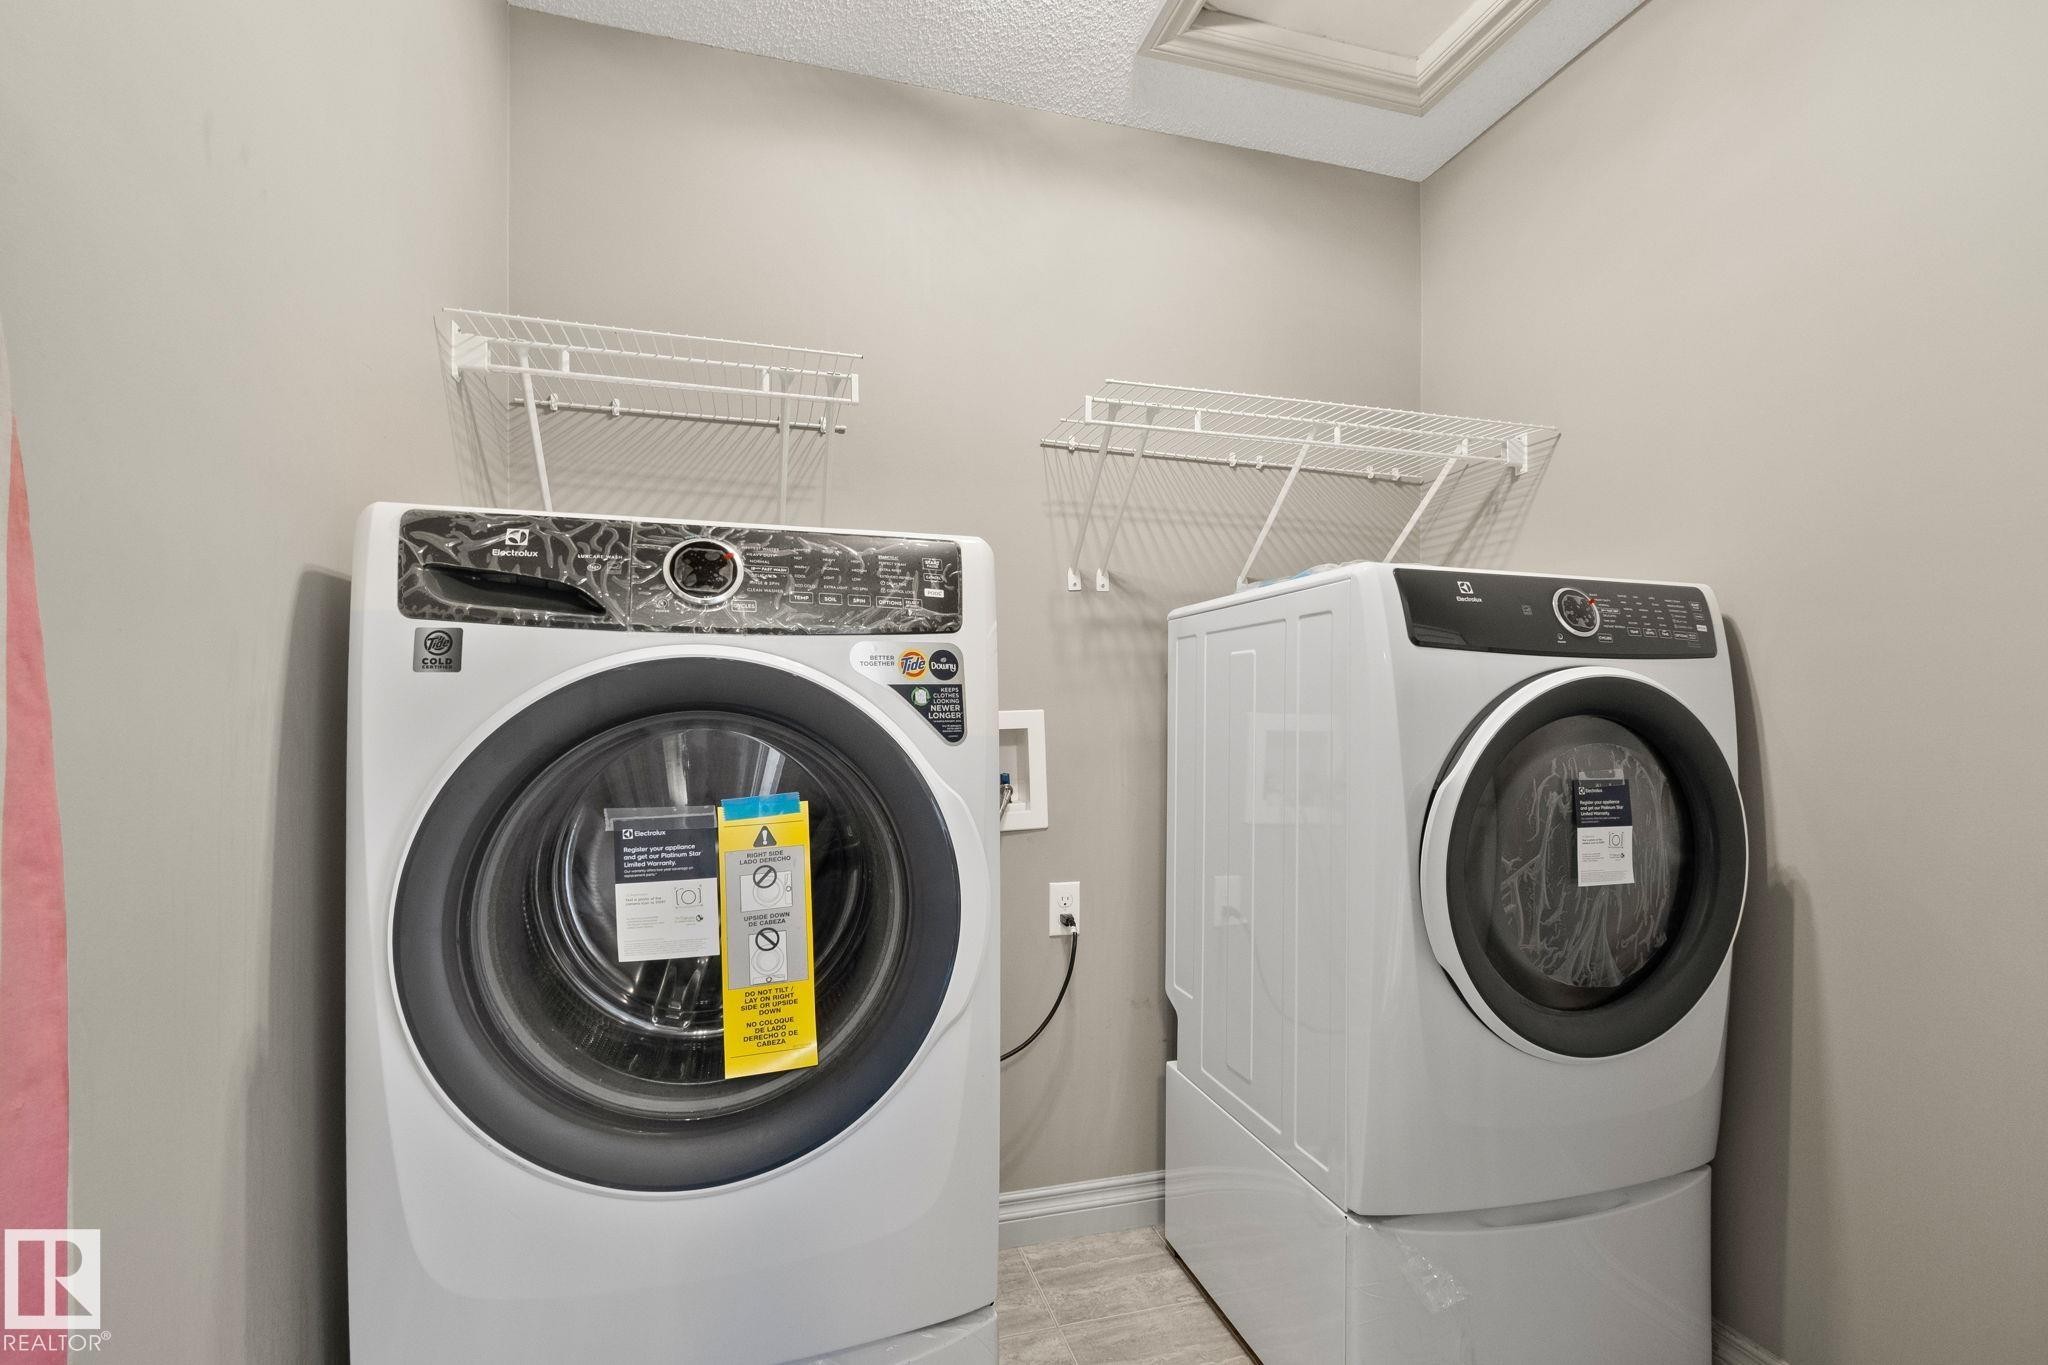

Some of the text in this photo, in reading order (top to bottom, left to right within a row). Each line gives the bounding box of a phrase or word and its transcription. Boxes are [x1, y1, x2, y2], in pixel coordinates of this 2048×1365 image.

[492, 549, 538, 557] Electrolux
[427, 635, 450, 651] Tide
[901, 656, 926, 674] Tide
[931, 662, 957, 672] Downy
[623, 846, 648, 854] Register
[637, 853, 648, 861] get
[743, 914, 768, 922] UPSIDE
[760, 918, 786, 926] CABEZA
[759, 1017, 794, 1026] COLOQUE
[744, 1032, 778, 1042] DERECHO
[757, 1039, 786, 1047] CABEZA
